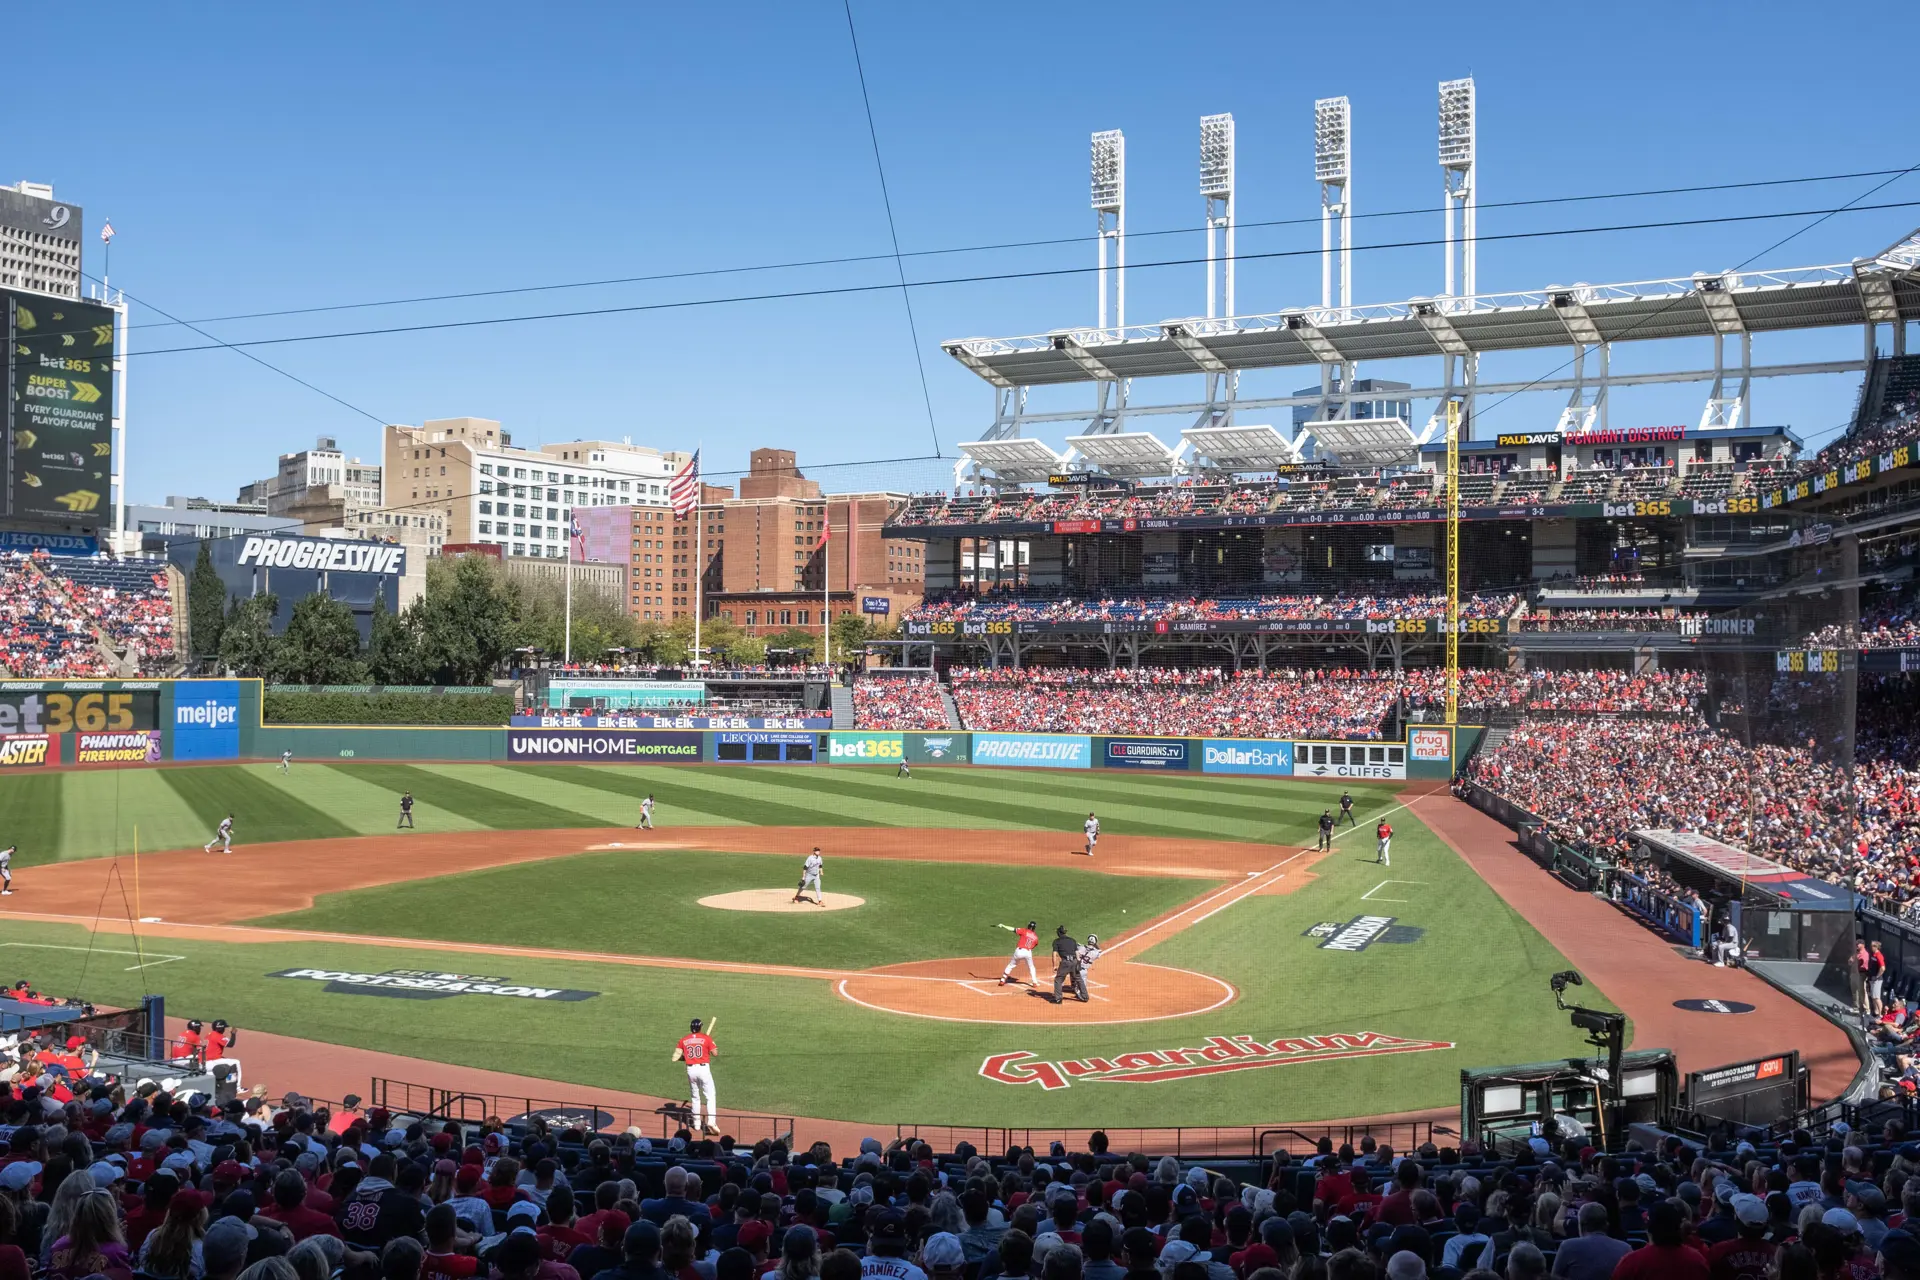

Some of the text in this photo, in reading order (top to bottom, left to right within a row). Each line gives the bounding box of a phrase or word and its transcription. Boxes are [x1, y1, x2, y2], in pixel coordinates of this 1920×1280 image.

[48, 206, 70, 230] 9
[40, 353, 91, 373] bet365
[29, 375, 67, 389] SUPER
[26, 385, 70, 400] BOOST
[24, 404, 104, 421] EVERY GUARDIANS
[32, 415, 96, 431] PLAYOFF GAME
[1567, 425, 1686, 445] PENNANT DISTRICT
[42, 452, 65, 461] bet365
[1879, 446, 1909, 473] bet365
[1844, 459, 1871, 484] bet365
[1814, 471, 1838, 493] bet365
[1787, 480, 1809, 502] bet365
[1763, 489, 1782, 509] bet365
[1417, 511, 1430, 519] 0.00
[1532, 507, 1545, 515] 3-2
[1603, 501, 1671, 516] bet365
[1243, 517, 1247, 525] 7
[1258, 516, 1266, 524] 13
[1333, 514, 1344, 522] 0.2
[1359, 513, 1375, 521] 0.00
[1386, 512, 1402, 520] 0.00
[1090, 522, 1097, 530] 4
[1146, 520, 1169, 528] SKUBAL
[11, 533, 88, 549] HONDA
[237, 537, 405, 574] PROGRESSIVE
[909, 622, 956, 634] bet365
[963, 622, 1012, 634] bet365
[1158, 623, 1165, 631] 11
[1173, 623, 1179, 631] J.
[1180, 621, 1207, 631] RAMÍREZ
[1366, 619, 1427, 633] bet365
[1680, 619, 1755, 635] THE CORNER
[1777, 651, 1804, 672] bet365
[1807, 650, 1838, 672] bet365
[1, 682, 45, 690] PROGRESSIVE
[322, 685, 372, 693] PROGRESSIVE
[673, 682, 702, 690] Guardians
[177, 700, 236, 728] meijer
[80, 734, 147, 749] PHANTOM
[1414, 731, 1442, 747] drug
[79, 748, 147, 762] FIREWORKS
[339, 749, 354, 757] 400
[636, 745, 697, 755] MORTGAGE
[830, 738, 903, 758] bet365
[975, 740, 1082, 761] PROGRESSIVE
[1416, 747, 1448, 757] mart
[1337, 766, 1392, 778] CLIFFS
[284, 969, 562, 999] POSTSEASON
[687, 1045, 703, 1058] 30
[979, 1034, 1412, 1091] Guardians
[1763, 1060, 1779, 1072] fubo
[342, 1201, 380, 1231] 38
[862, 1262, 909, 1280] RAMÍREZ
